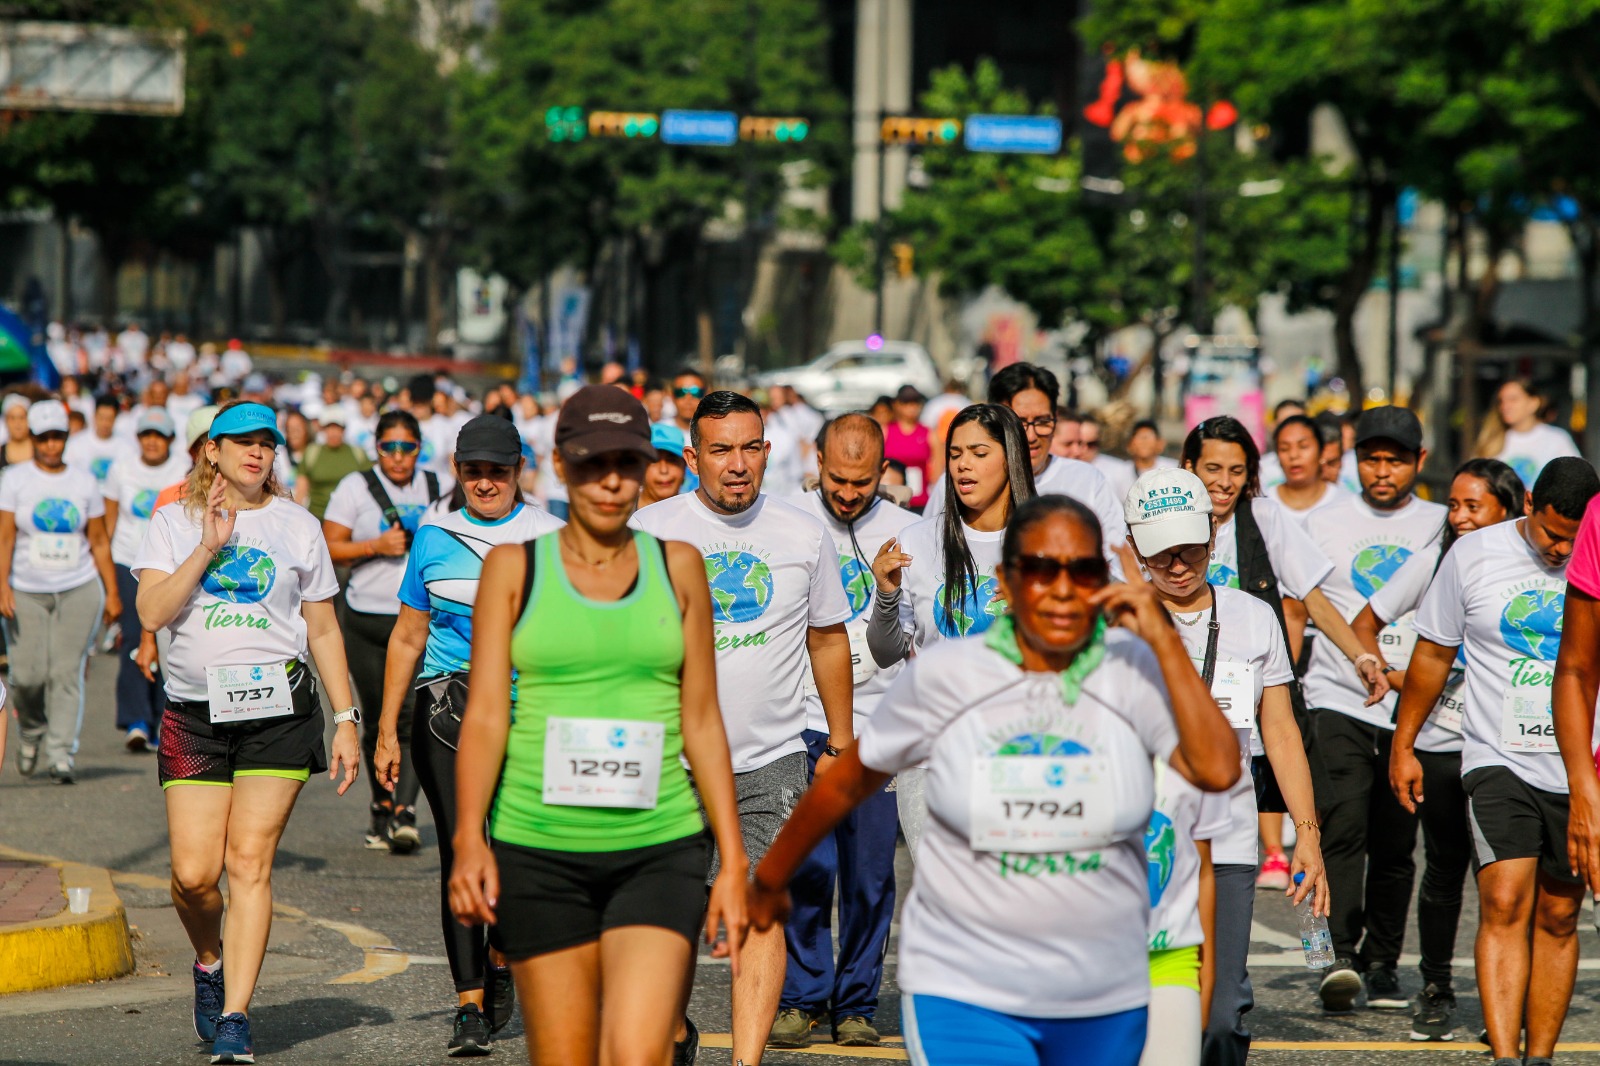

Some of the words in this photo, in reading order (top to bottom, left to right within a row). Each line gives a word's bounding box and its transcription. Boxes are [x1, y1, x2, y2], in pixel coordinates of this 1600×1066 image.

[1138, 486, 1194, 508] ARUBA
[1152, 506, 1173, 516] HAPPY
[203, 601, 272, 630] Tierra
[1377, 634, 1401, 646] 81
[217, 668, 239, 684] 5K
[1508, 656, 1554, 688] Tier
[226, 686, 275, 702] 1737
[1518, 723, 1555, 736] 146
[569, 758, 642, 778] 1295
[1001, 800, 1084, 820] 1794
